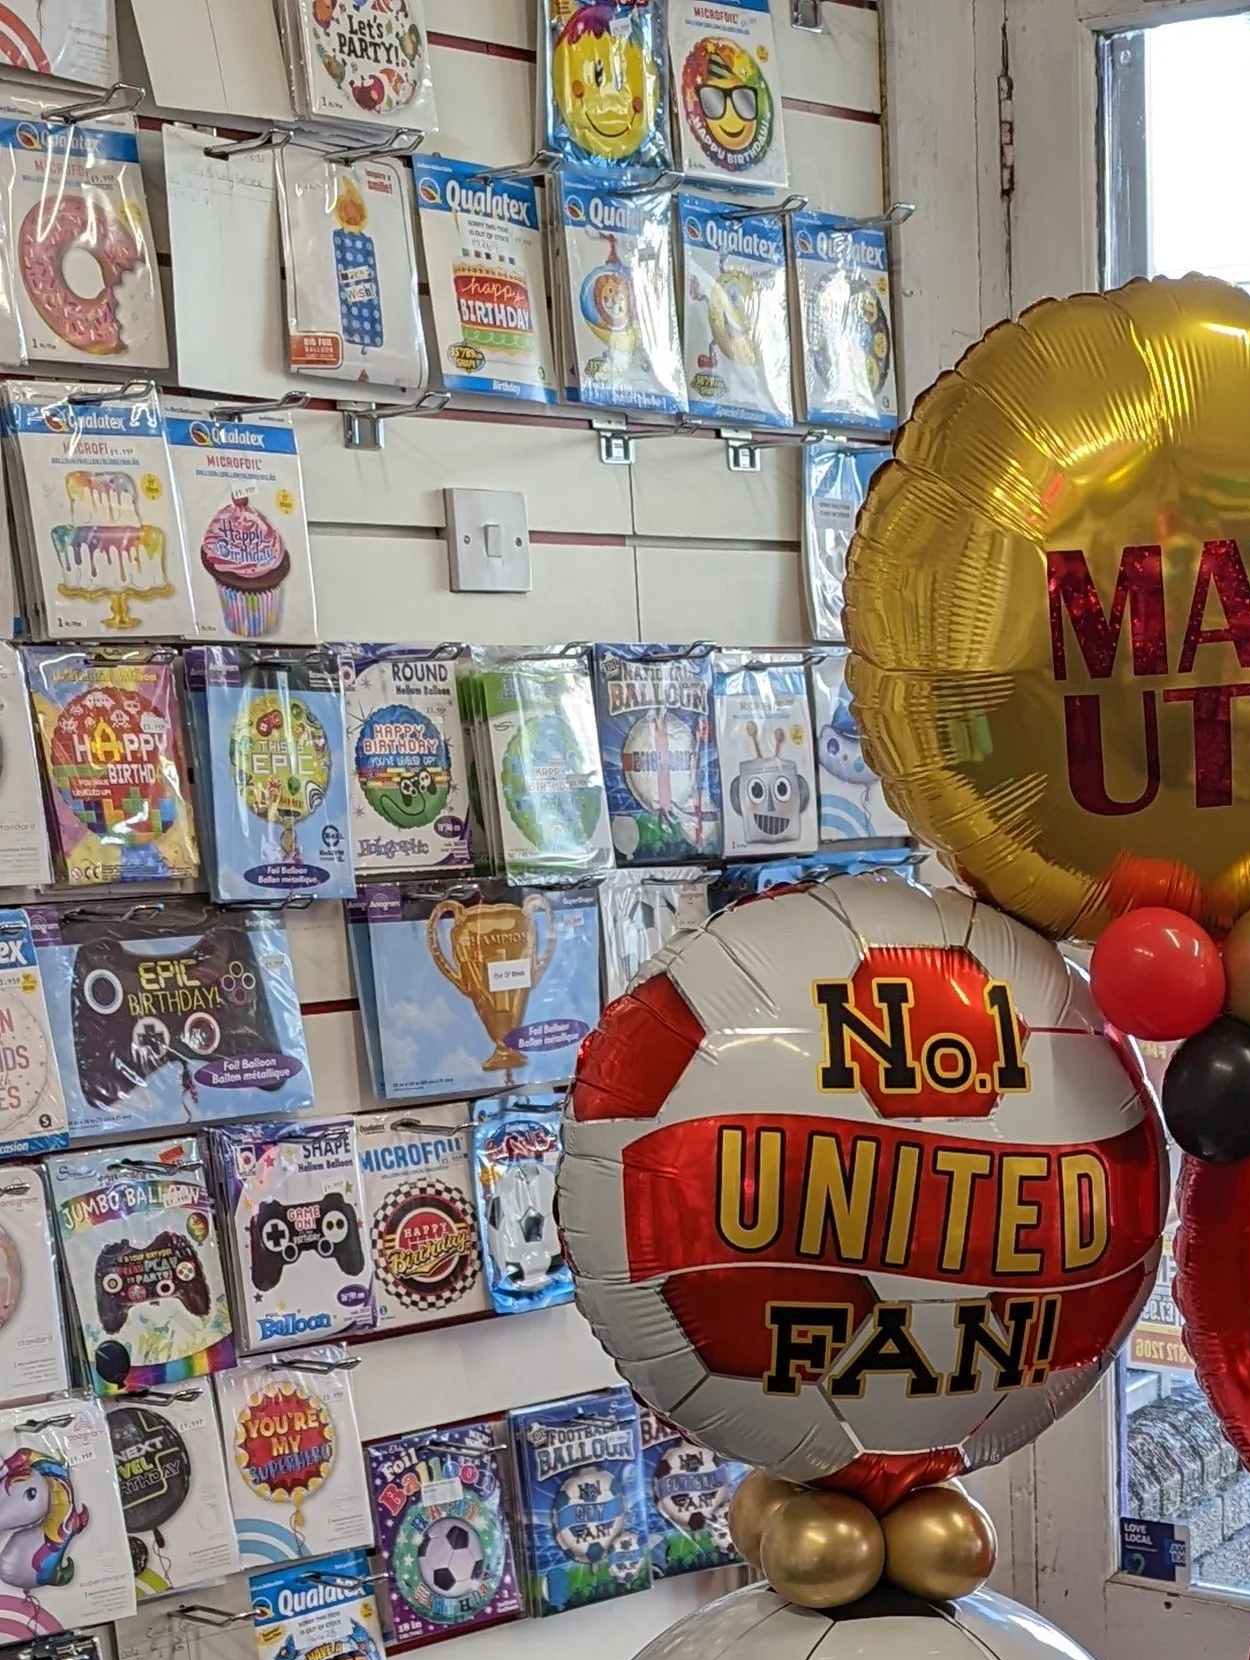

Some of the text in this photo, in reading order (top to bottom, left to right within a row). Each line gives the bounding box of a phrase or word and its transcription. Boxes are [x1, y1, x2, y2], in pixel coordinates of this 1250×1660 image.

[347, 14, 384, 41] Let's
[337, 31, 402, 67] PARTY!
[690, 117, 726, 162] HAPPY
[446, 180, 532, 226] Qualatex
[706, 220, 780, 262] Qualatex
[461, 277, 525, 306] happy
[460, 298, 531, 331] BIRTHDAY
[492, 379, 521, 395] Birthday
[66, 411, 126, 432] Qualatex
[211, 425, 265, 447] Qualatex
[207, 455, 261, 471] MICROFOIL
[222, 519, 265, 550] Happy
[215, 536, 275, 565] Birthday
[392, 663, 448, 683] ROUND
[424, 685, 451, 696] Balloon
[373, 724, 426, 741] HAPPY
[258, 738, 287, 752] THIS
[364, 740, 439, 756] BIRTHDAY
[253, 752, 314, 776] EPIC
[267, 866, 308, 877] Foil Balloon
[138, 959, 201, 991] EPIC
[128, 986, 221, 1017] BIRTHDAY!
[529, 1024, 542, 1035] Foil
[813, 978, 1030, 1094] No.1
[212, 1066, 290, 1085] Ballon métallique
[223, 1057, 277, 1071] Foil Balloon
[302, 1138, 350, 1160] SHAPE
[326, 1157, 354, 1171] Balloon
[63, 1189, 121, 1231] JUMBO
[715, 1124, 1112, 1276] UNITED
[287, 1205, 320, 1221] GAME
[403, 1222, 448, 1239] HAPPY
[388, 1231, 469, 1277] Birthday
[256, 1311, 332, 1341] Balloon
[763, 1294, 1062, 1398] FAN!
[246, 1409, 320, 1439] YOU'RE
[114, 1436, 163, 1461] NEXT
[271, 1435, 301, 1456] MY
[118, 1456, 154, 1479] VEL
[379, 1447, 420, 1482] Foil
[121, 1460, 181, 1495] RTHDAY
[379, 1456, 496, 1517] Balloon
[1124, 1522, 1147, 1535] LOVE
[1124, 1532, 1153, 1546] LOCAL
